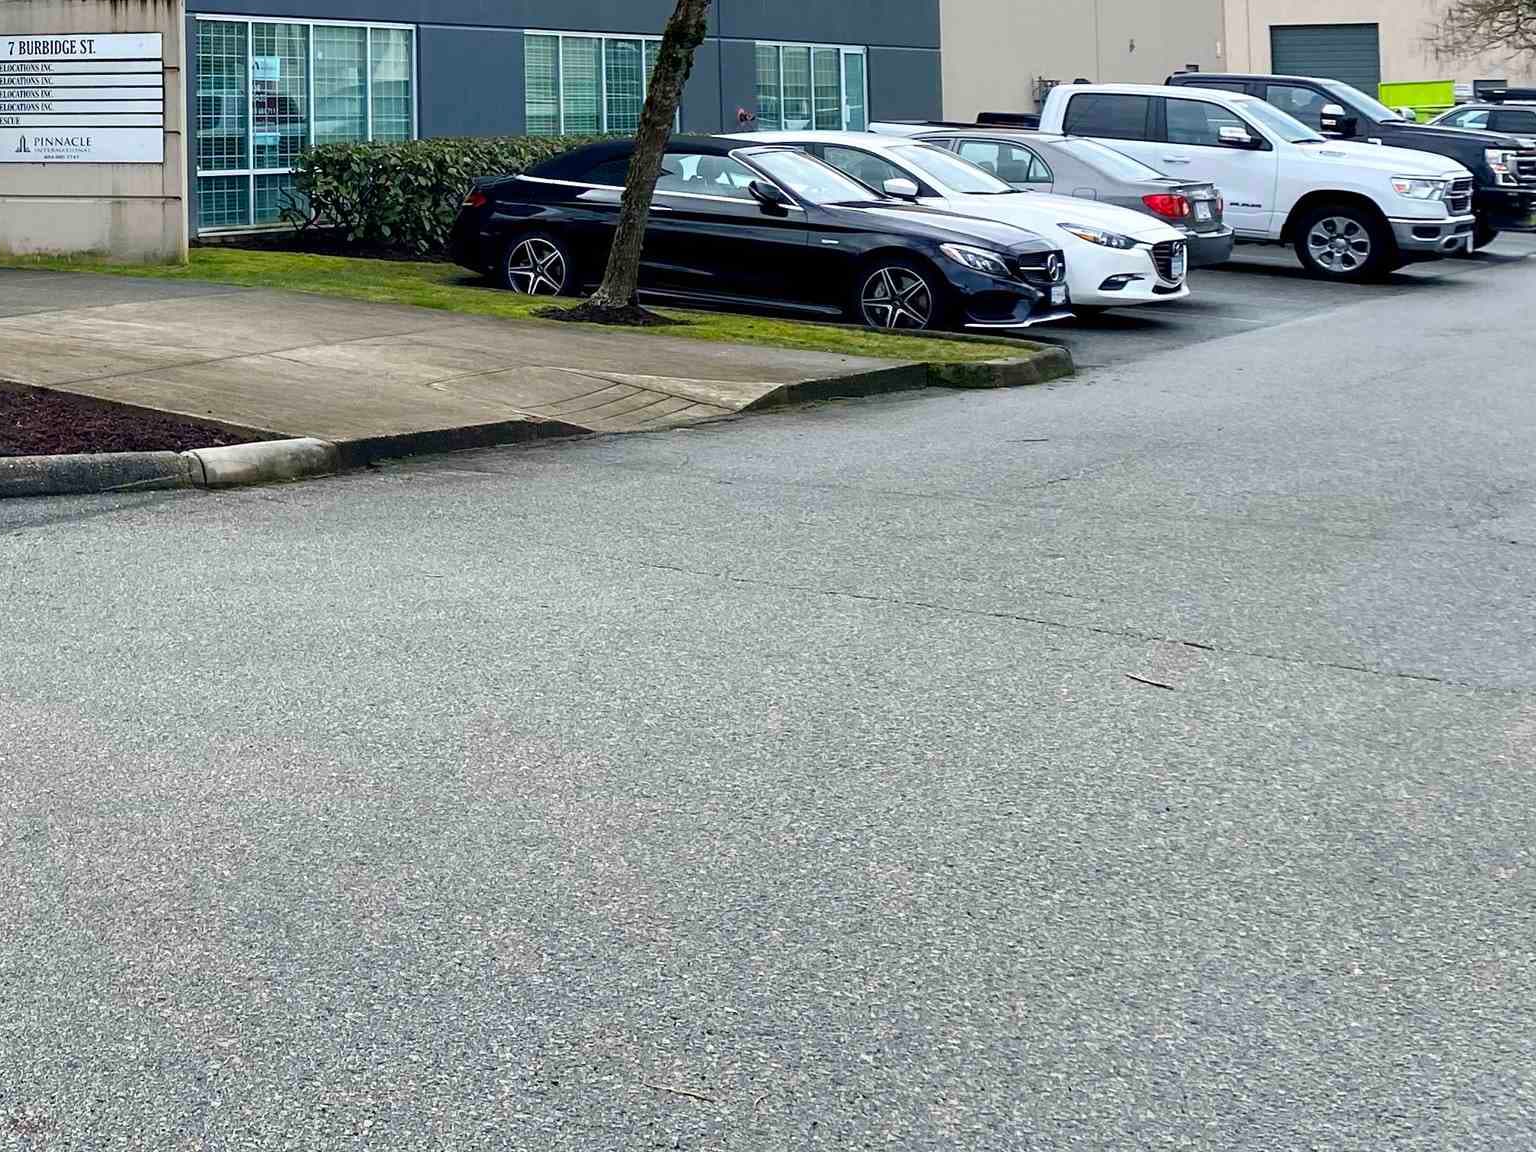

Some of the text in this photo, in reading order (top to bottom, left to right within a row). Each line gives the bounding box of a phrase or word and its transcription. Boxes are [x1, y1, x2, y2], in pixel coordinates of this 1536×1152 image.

[8, 39, 96, 56] 7 BURBIDGE ST.
[34, 136, 92, 147] PINNACLE
